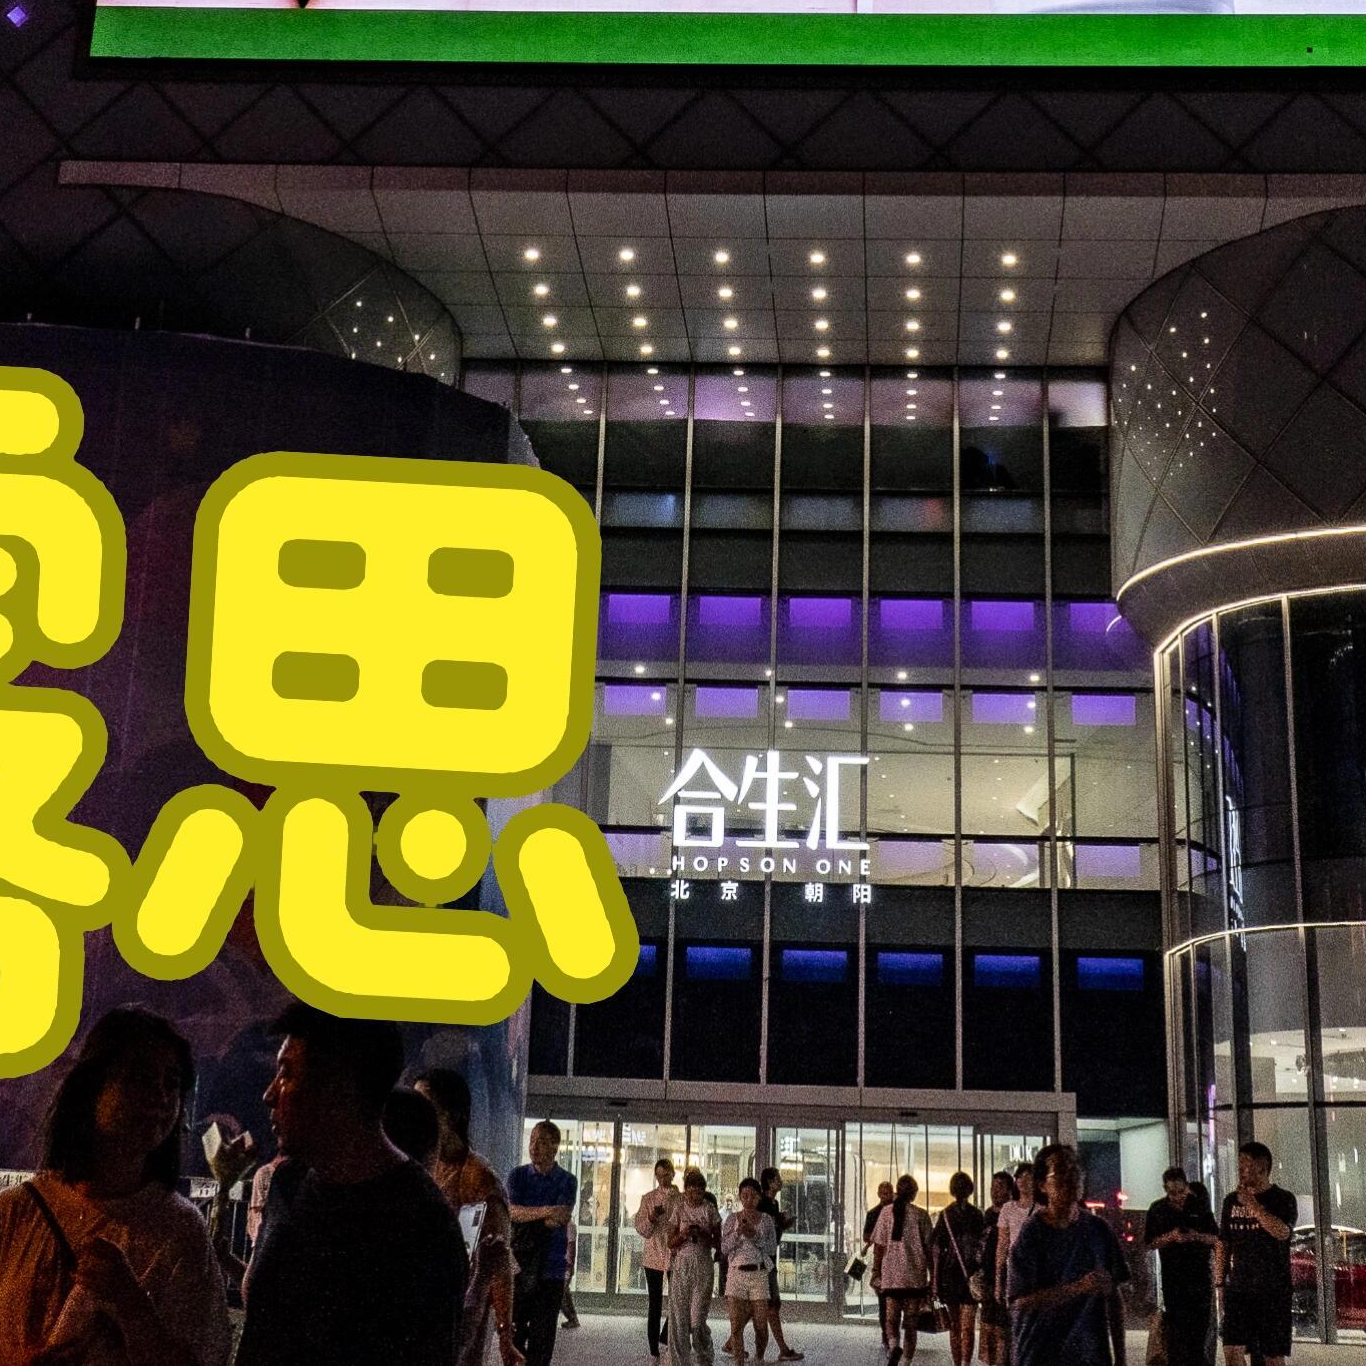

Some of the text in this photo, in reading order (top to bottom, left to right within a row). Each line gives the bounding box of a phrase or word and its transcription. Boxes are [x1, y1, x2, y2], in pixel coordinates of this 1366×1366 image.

[657, 748, 871, 851] 合生汇
[671, 855, 871, 875] HOPSON ONE
[670, 879, 872, 904] 北京 朝阳
